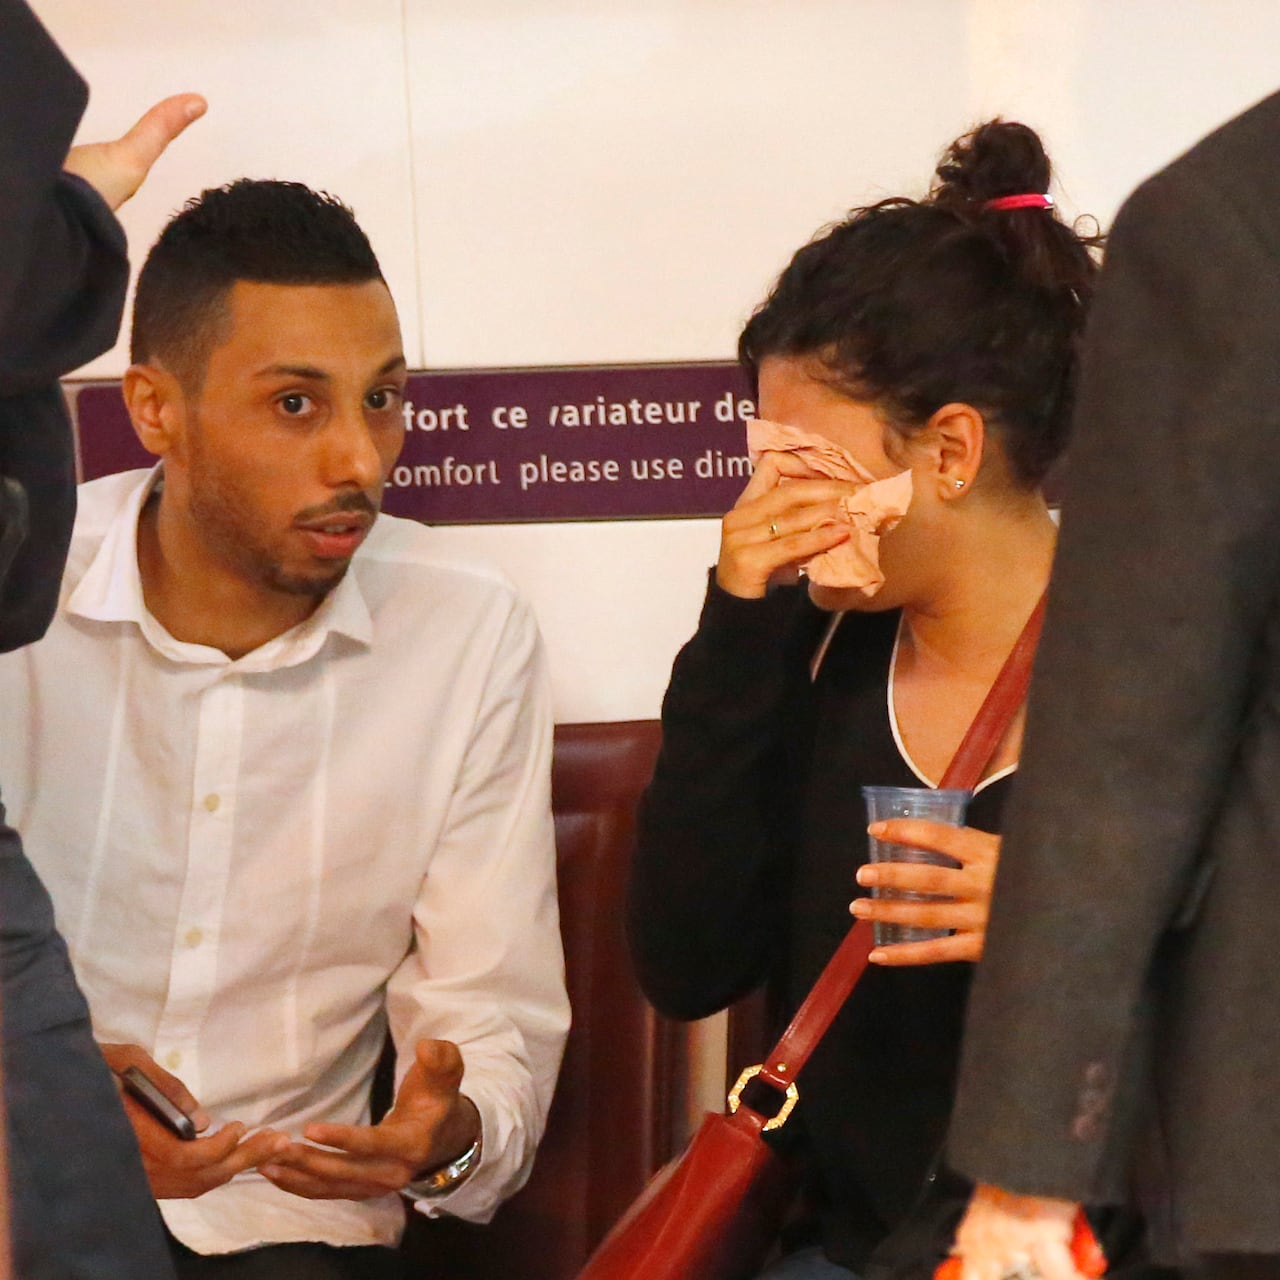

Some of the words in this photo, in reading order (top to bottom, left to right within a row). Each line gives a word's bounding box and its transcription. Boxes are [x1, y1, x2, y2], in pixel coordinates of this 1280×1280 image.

[402, 401, 470, 431] fort
[492, 406, 528, 430] ce
[714, 391, 756, 422] de
[384, 456, 501, 488] omfort
[520, 454, 620, 491] please
[631, 458, 684, 481] use
